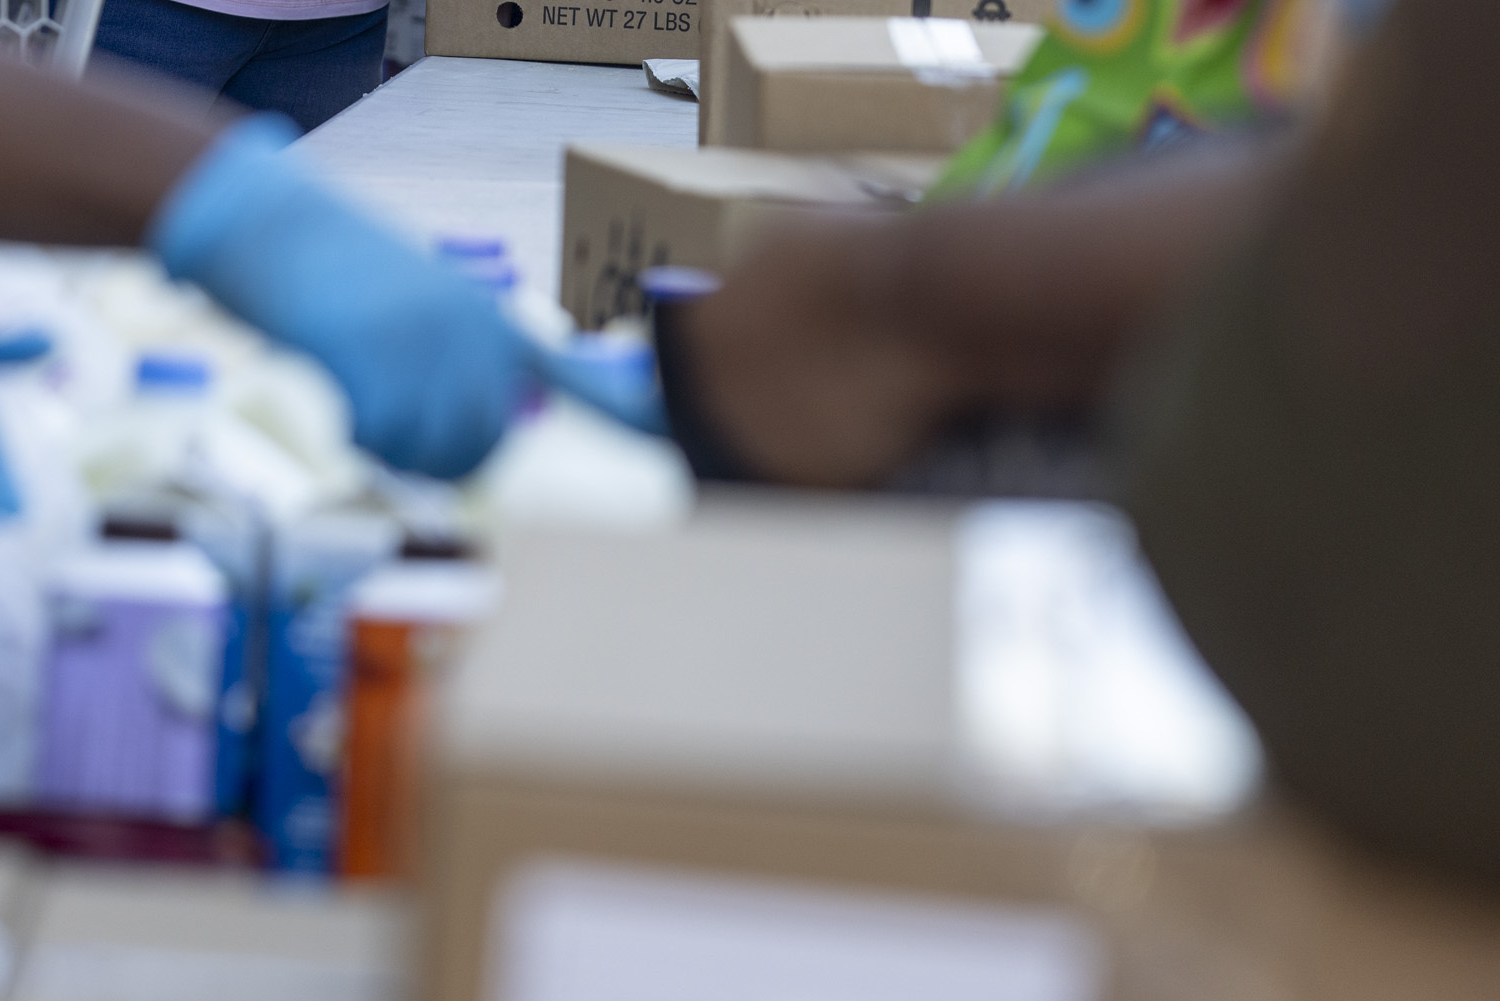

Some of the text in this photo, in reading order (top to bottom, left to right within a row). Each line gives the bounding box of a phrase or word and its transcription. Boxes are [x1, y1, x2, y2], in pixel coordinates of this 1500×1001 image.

[542, 5, 691, 33] NET WT 27 LBS
